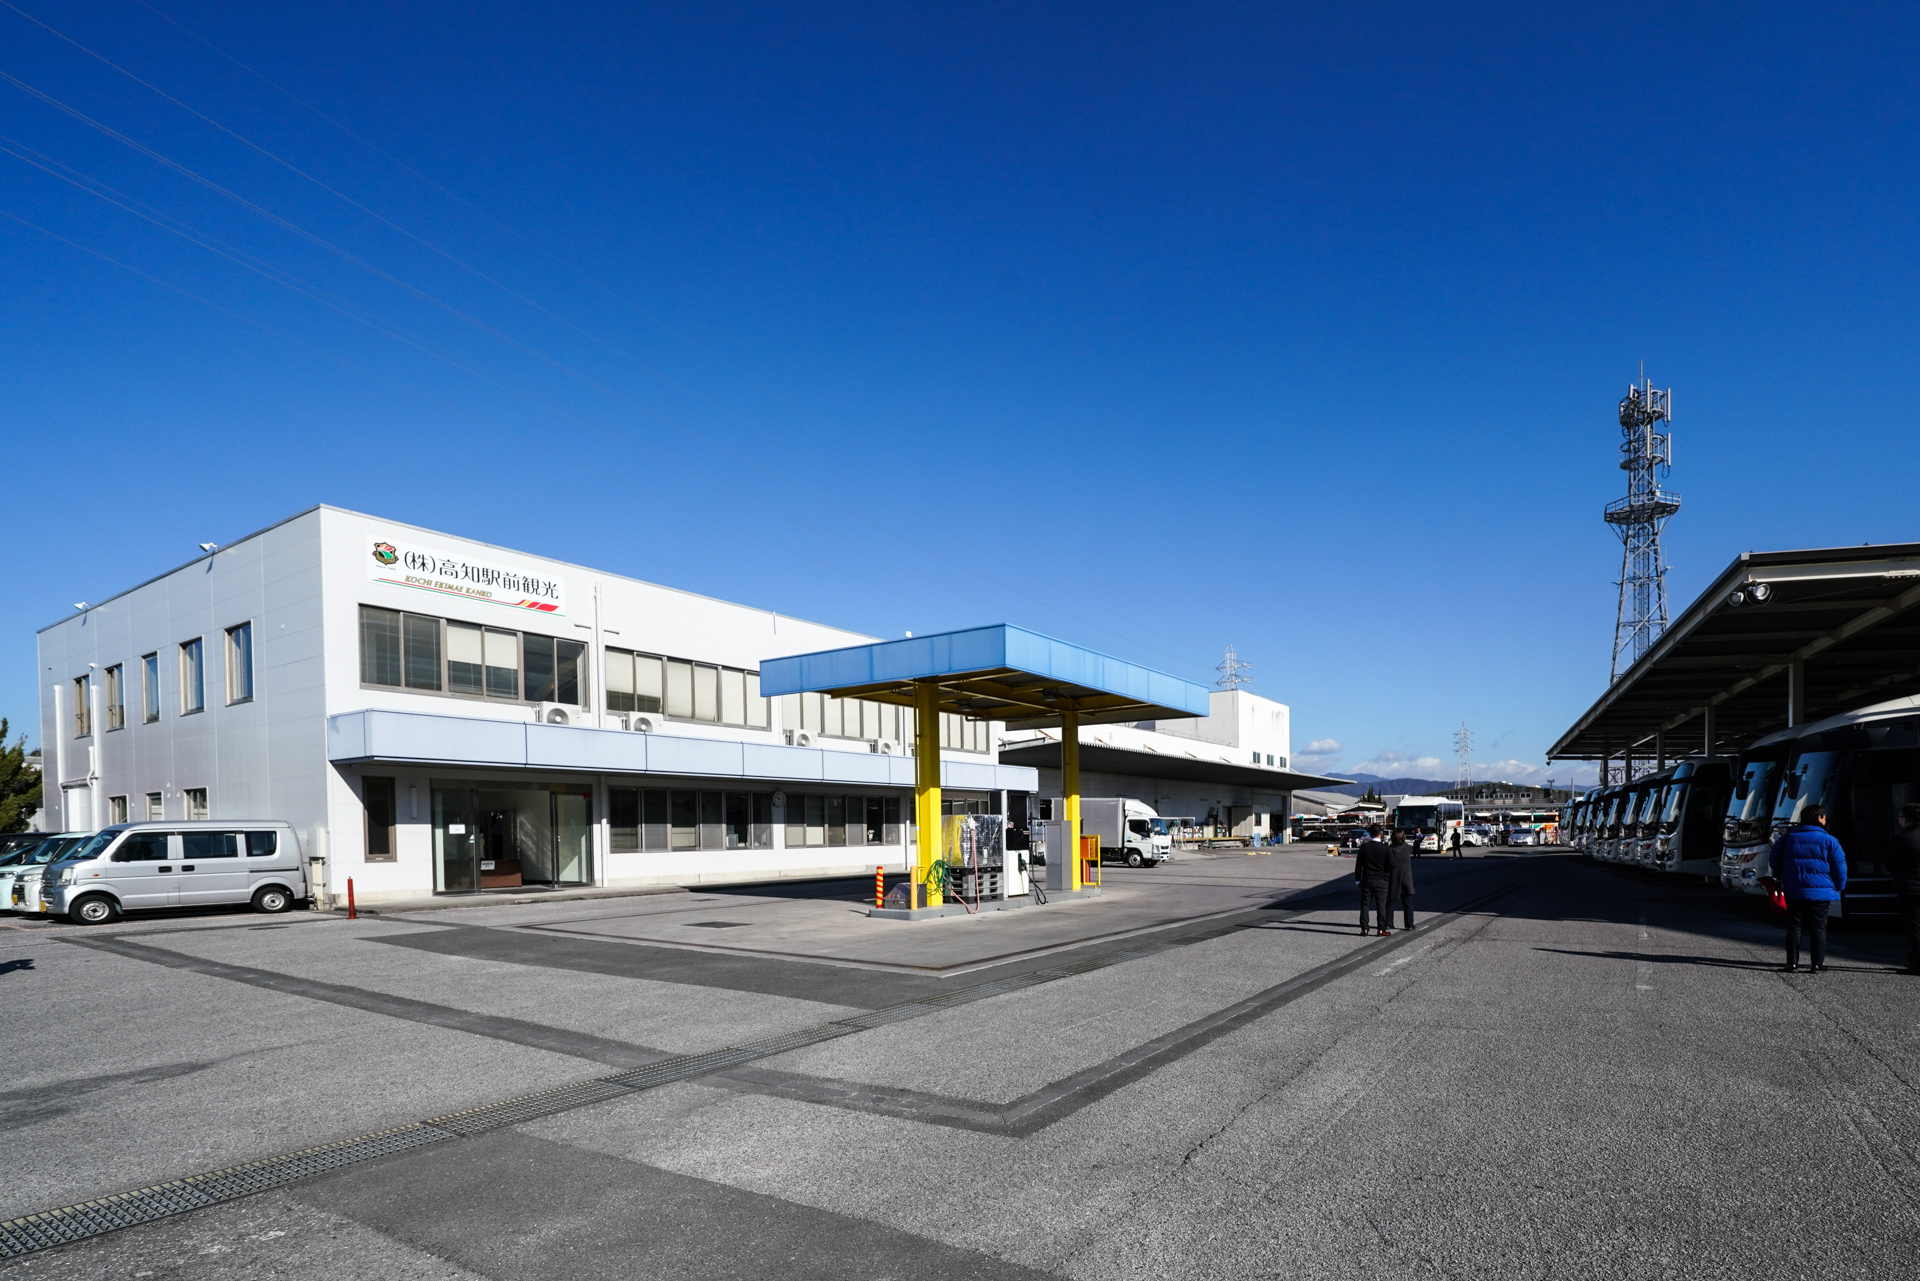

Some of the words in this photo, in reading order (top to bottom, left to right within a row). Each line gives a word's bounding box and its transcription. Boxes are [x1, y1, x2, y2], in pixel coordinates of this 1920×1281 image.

[405, 575, 433, 587] KOCHI
[434, 580, 464, 593] EKIMAE
[467, 587, 493, 599] KANKO
